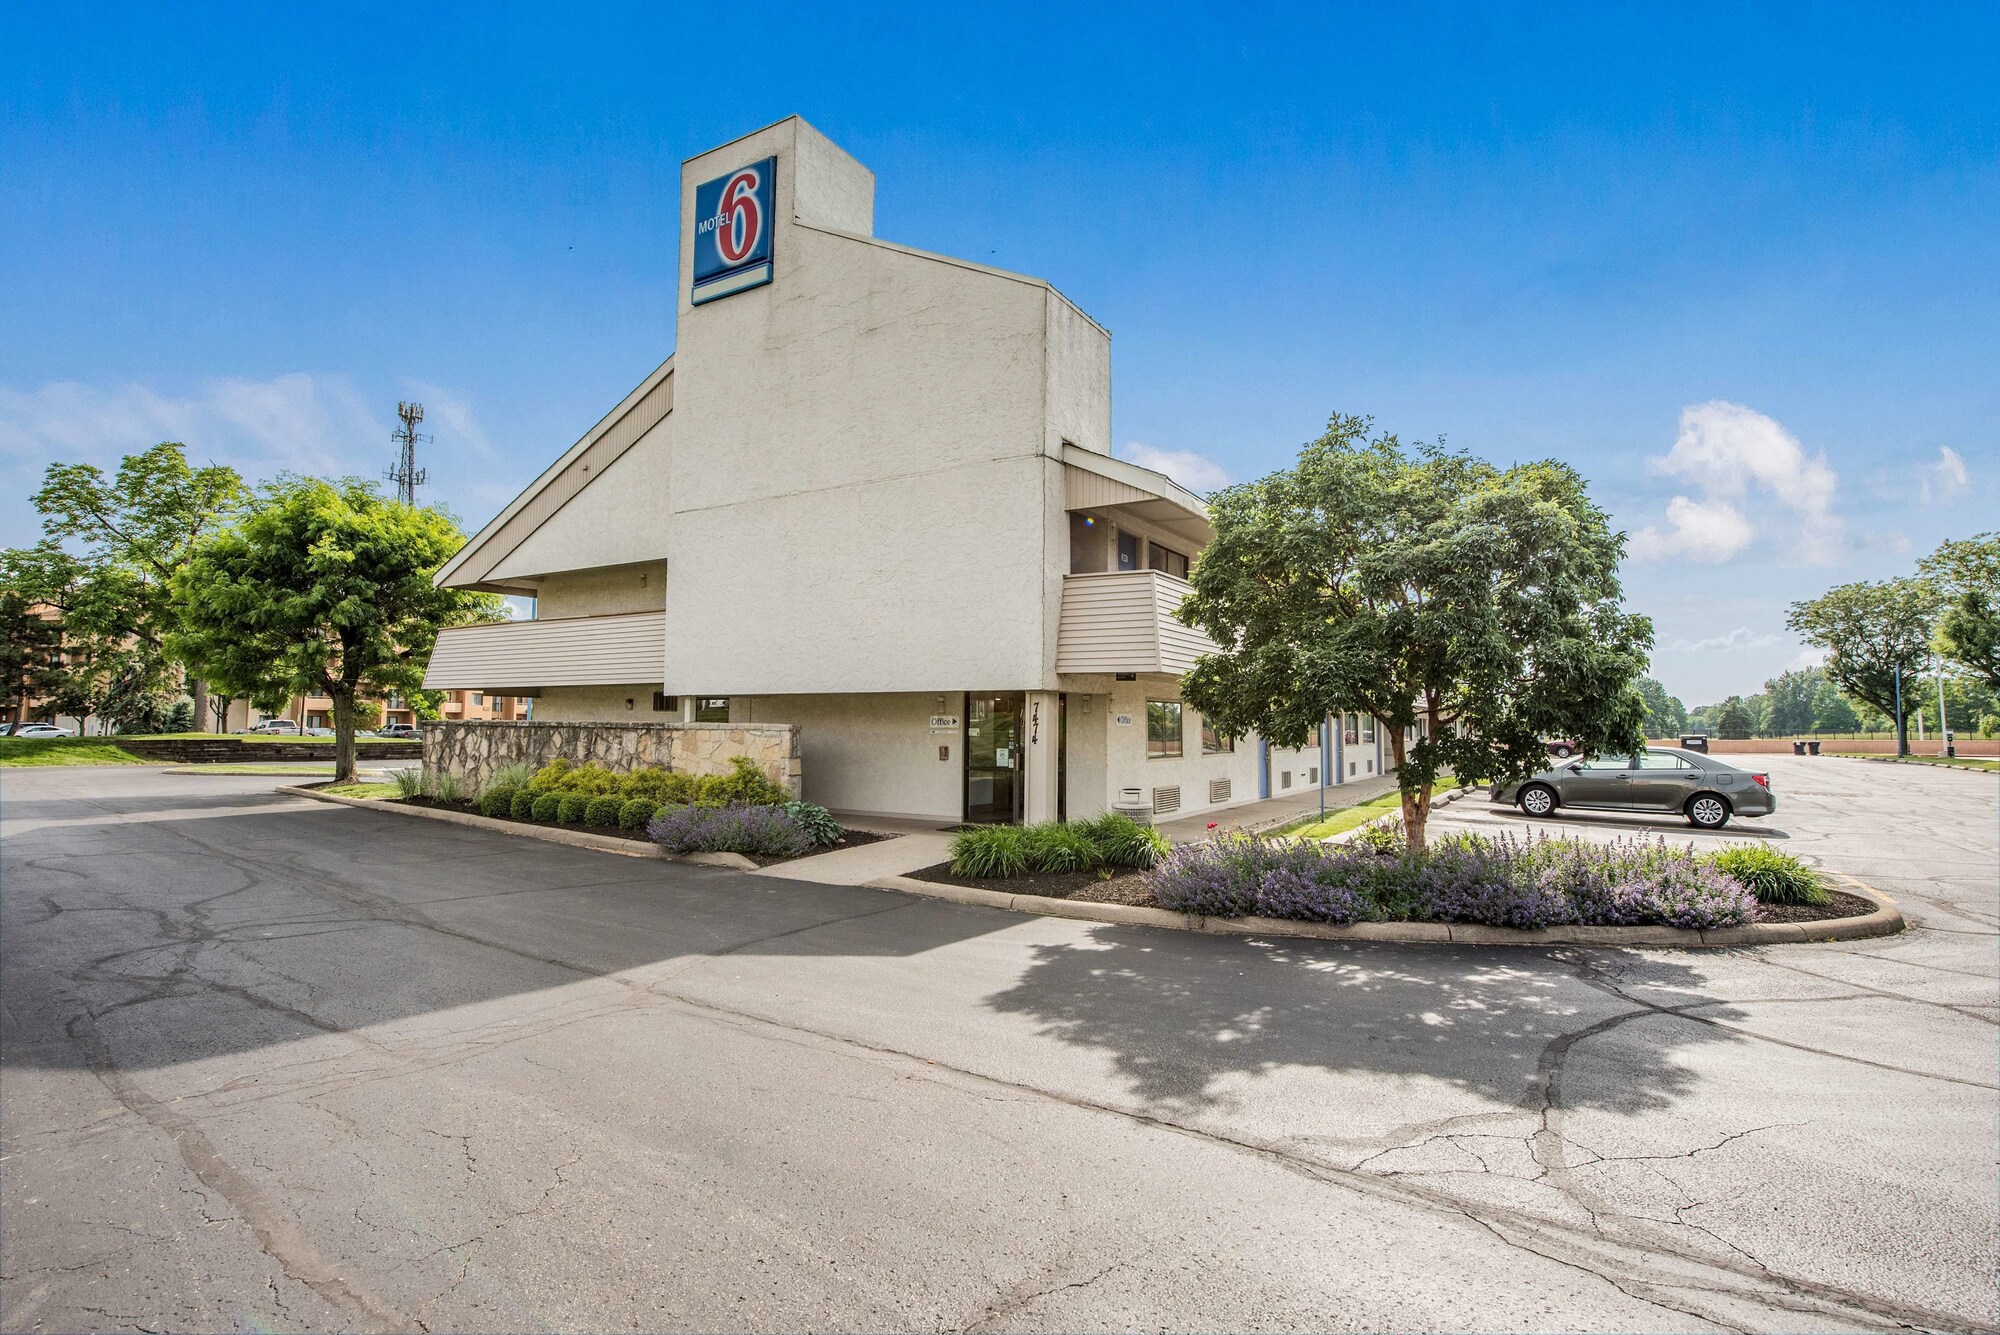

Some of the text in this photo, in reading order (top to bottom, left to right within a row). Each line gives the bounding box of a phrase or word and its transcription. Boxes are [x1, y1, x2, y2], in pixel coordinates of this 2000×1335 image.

[698, 170, 760, 263] MOTEL 6
[931, 717, 951, 726] Office
[1031, 701, 1040, 745] 7474
[1119, 715, 1132, 724] Office
